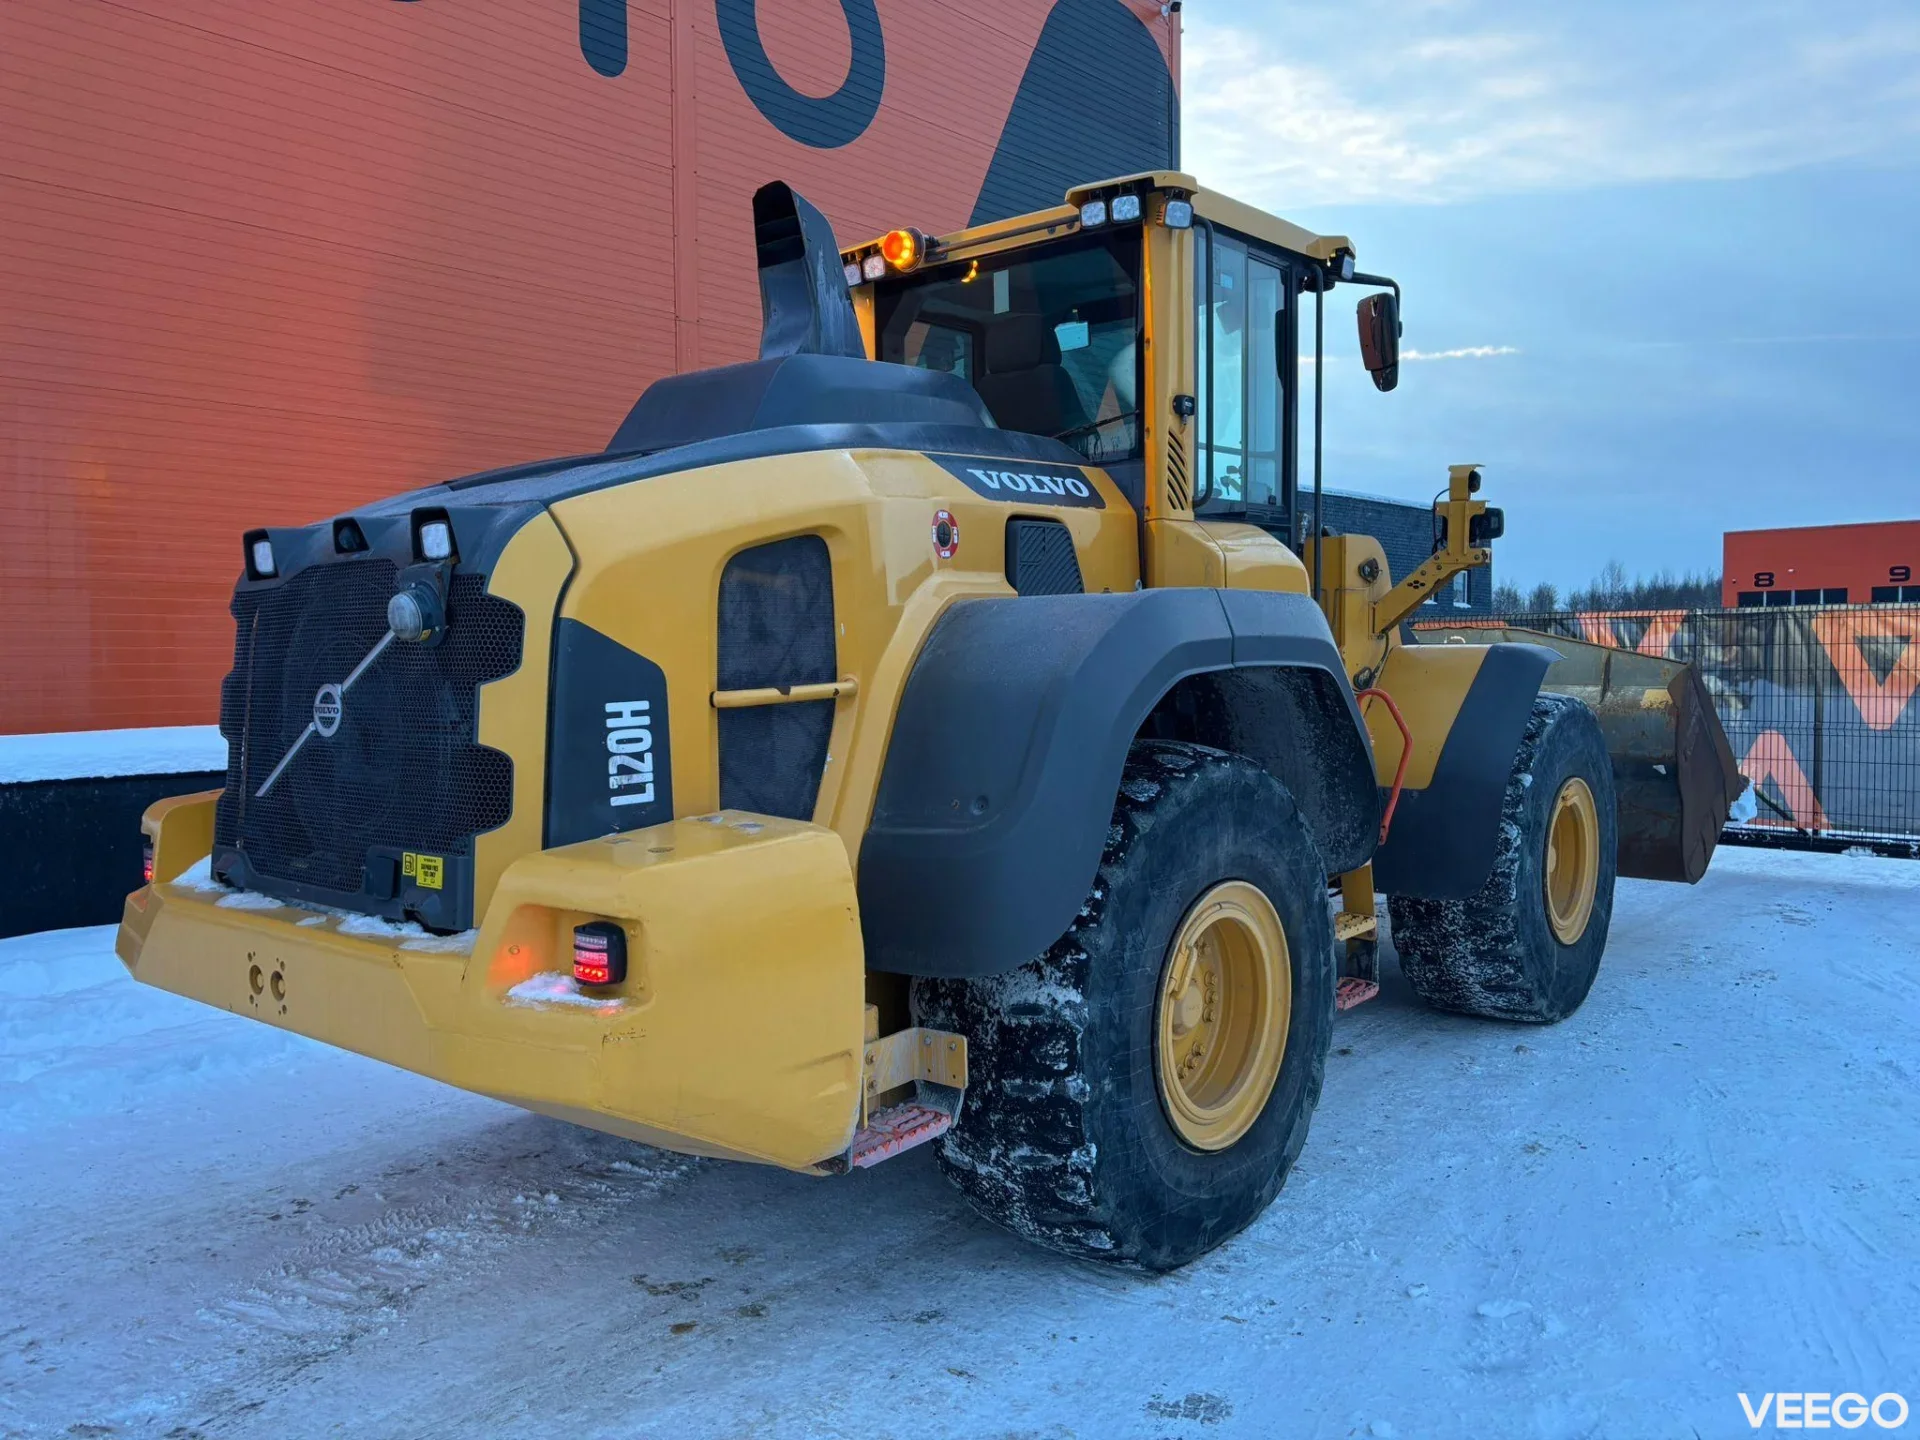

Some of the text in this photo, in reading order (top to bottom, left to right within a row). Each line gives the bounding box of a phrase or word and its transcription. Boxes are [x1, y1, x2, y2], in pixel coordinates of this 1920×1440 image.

[966, 468, 1090, 498] VOLVO
[1753, 571, 1775, 587] 8
[1889, 565, 1911, 582] 9
[314, 706, 340, 715] VOLVO
[605, 700, 655, 807] L120H
